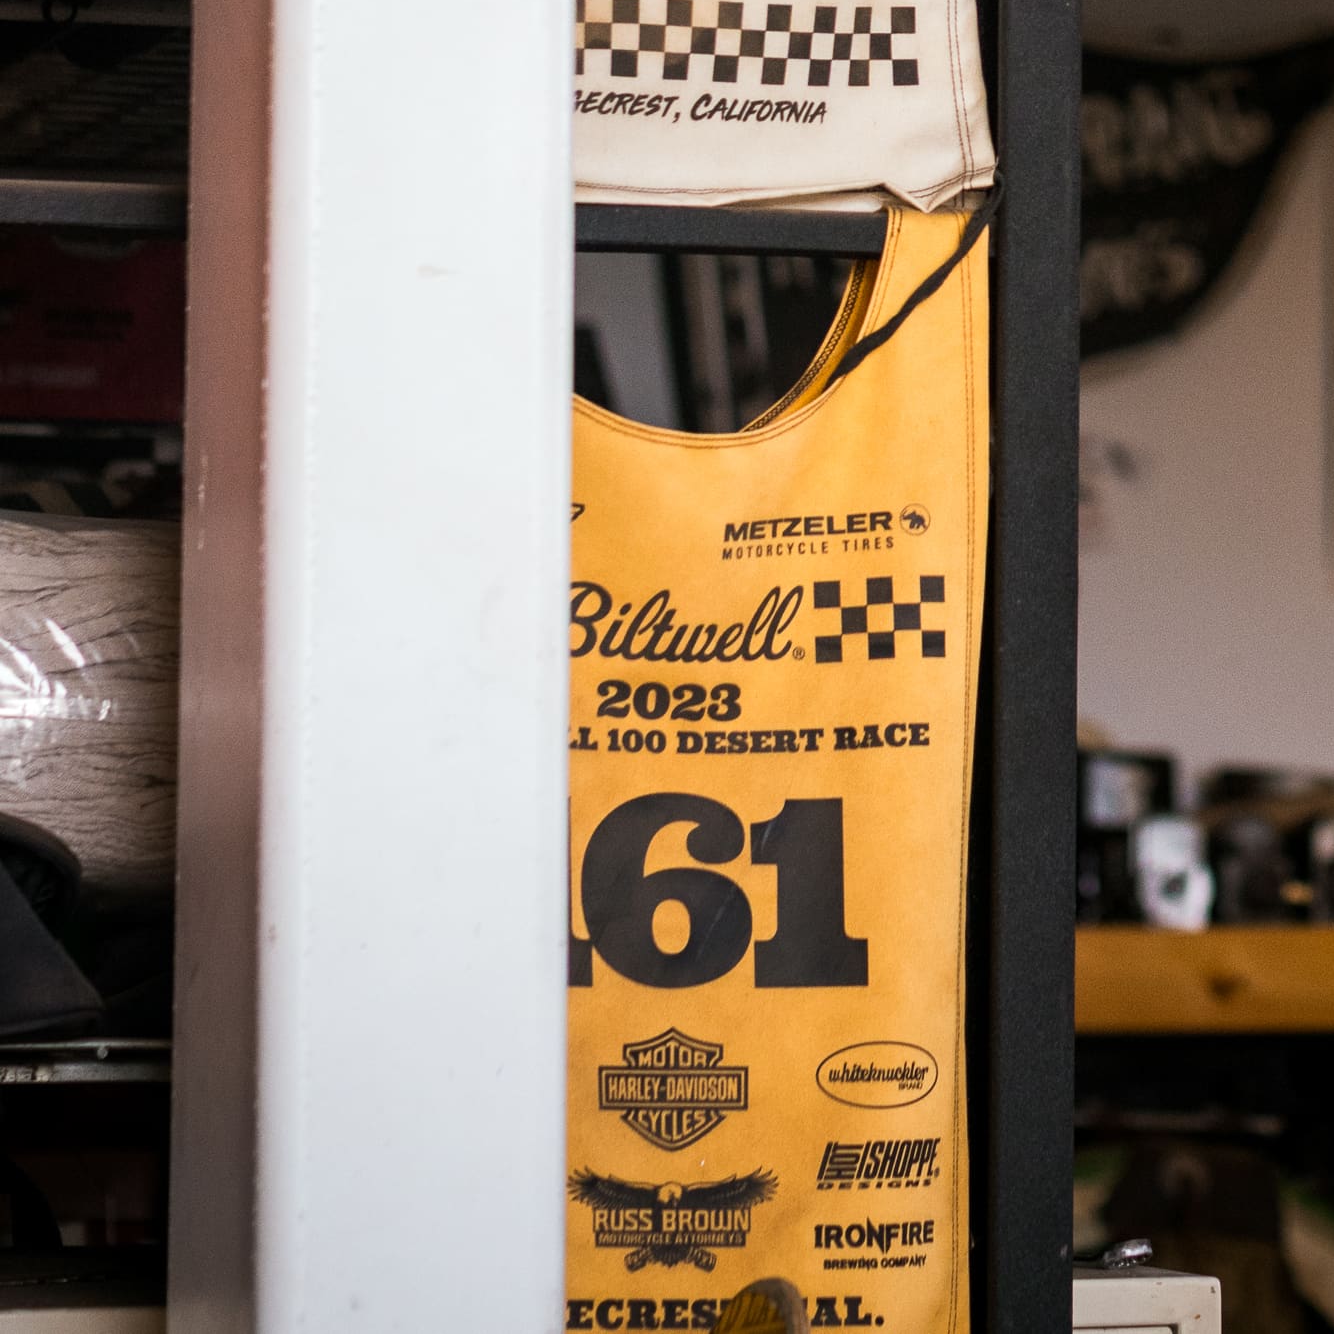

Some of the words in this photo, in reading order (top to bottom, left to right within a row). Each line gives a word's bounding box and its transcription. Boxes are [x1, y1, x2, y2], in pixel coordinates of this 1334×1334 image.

[690, 93, 828, 124] CALIFORNIA
[723, 511, 892, 542] METZELER
[721, 541, 829, 560] MOTORCYCLE
[843, 536, 895, 553] TIRES
[597, 679, 742, 722] 2023
[607, 728, 667, 753] 100
[676, 728, 825, 755] DESERT
[833, 722, 931, 751] RACE
[638, 1040, 708, 1068] MOTOR
[828, 1060, 929, 1083] whiteknuckler
[608, 1075, 739, 1102] HARLEY-DAVIDSON
[638, 1108, 707, 1142] CYCLES
[816, 1178, 932, 1190] DESIGNS
[594, 1209, 653, 1232] RUSS
[661, 1209, 750, 1232] BROWN
[598, 1232, 671, 1246] MOTORCYCLE
[814, 1215, 935, 1255] IRONFIRE
